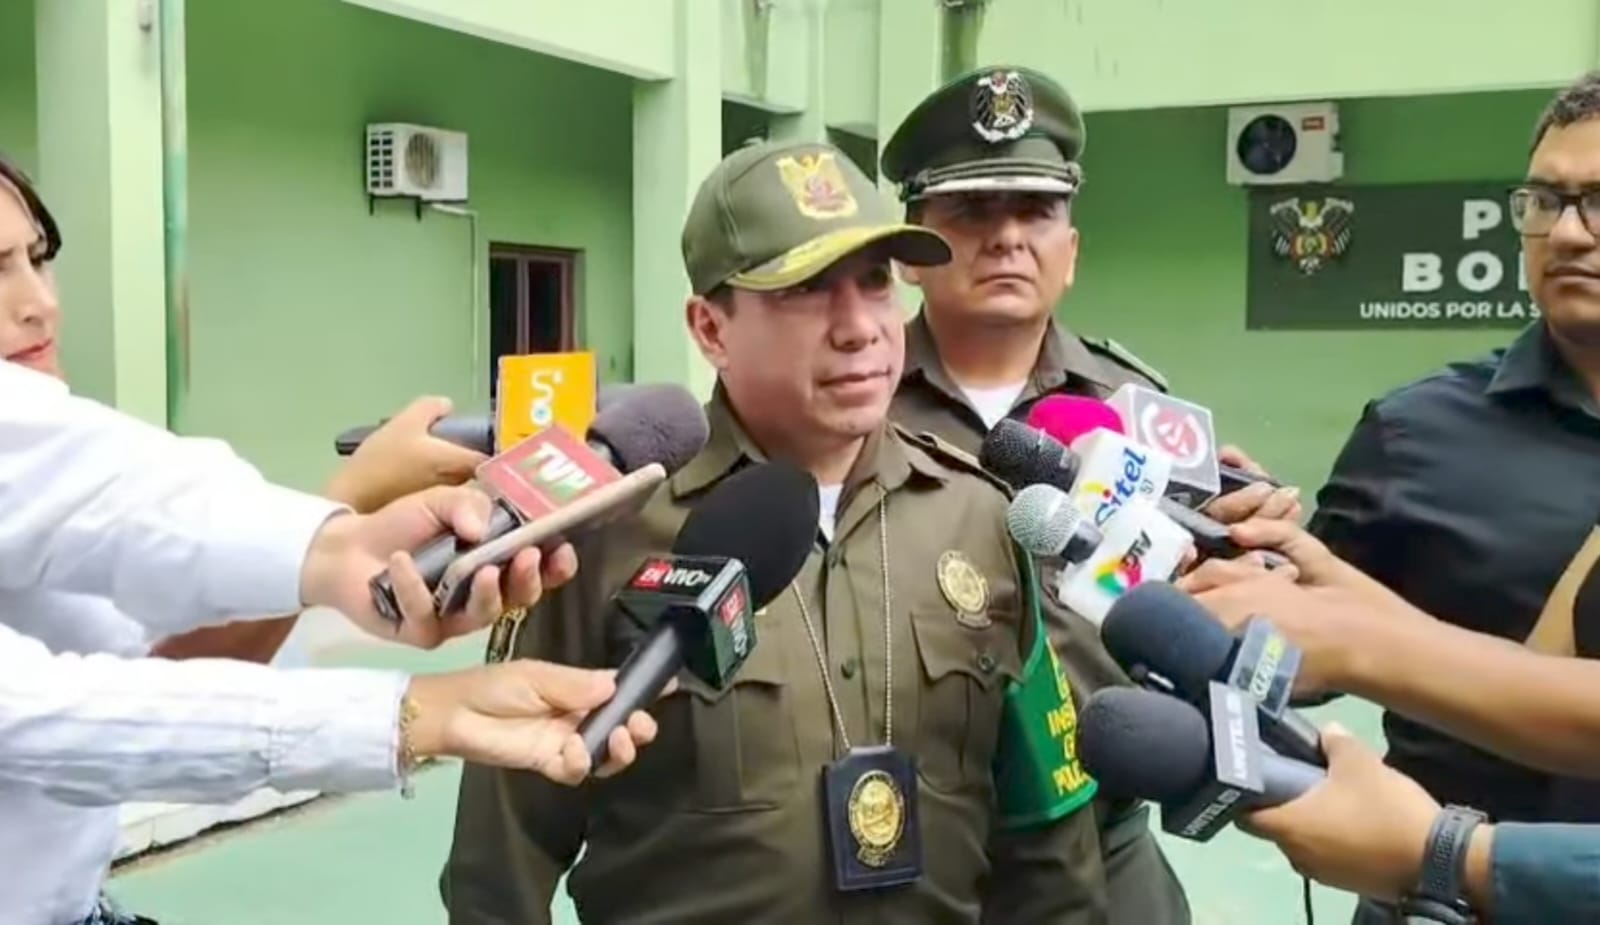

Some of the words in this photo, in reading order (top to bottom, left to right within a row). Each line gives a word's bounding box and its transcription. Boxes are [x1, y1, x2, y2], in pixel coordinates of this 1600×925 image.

[1359, 302, 1441, 319] UNIDOS
[1446, 302, 1491, 319] POR
[1497, 301, 1525, 318] LA
